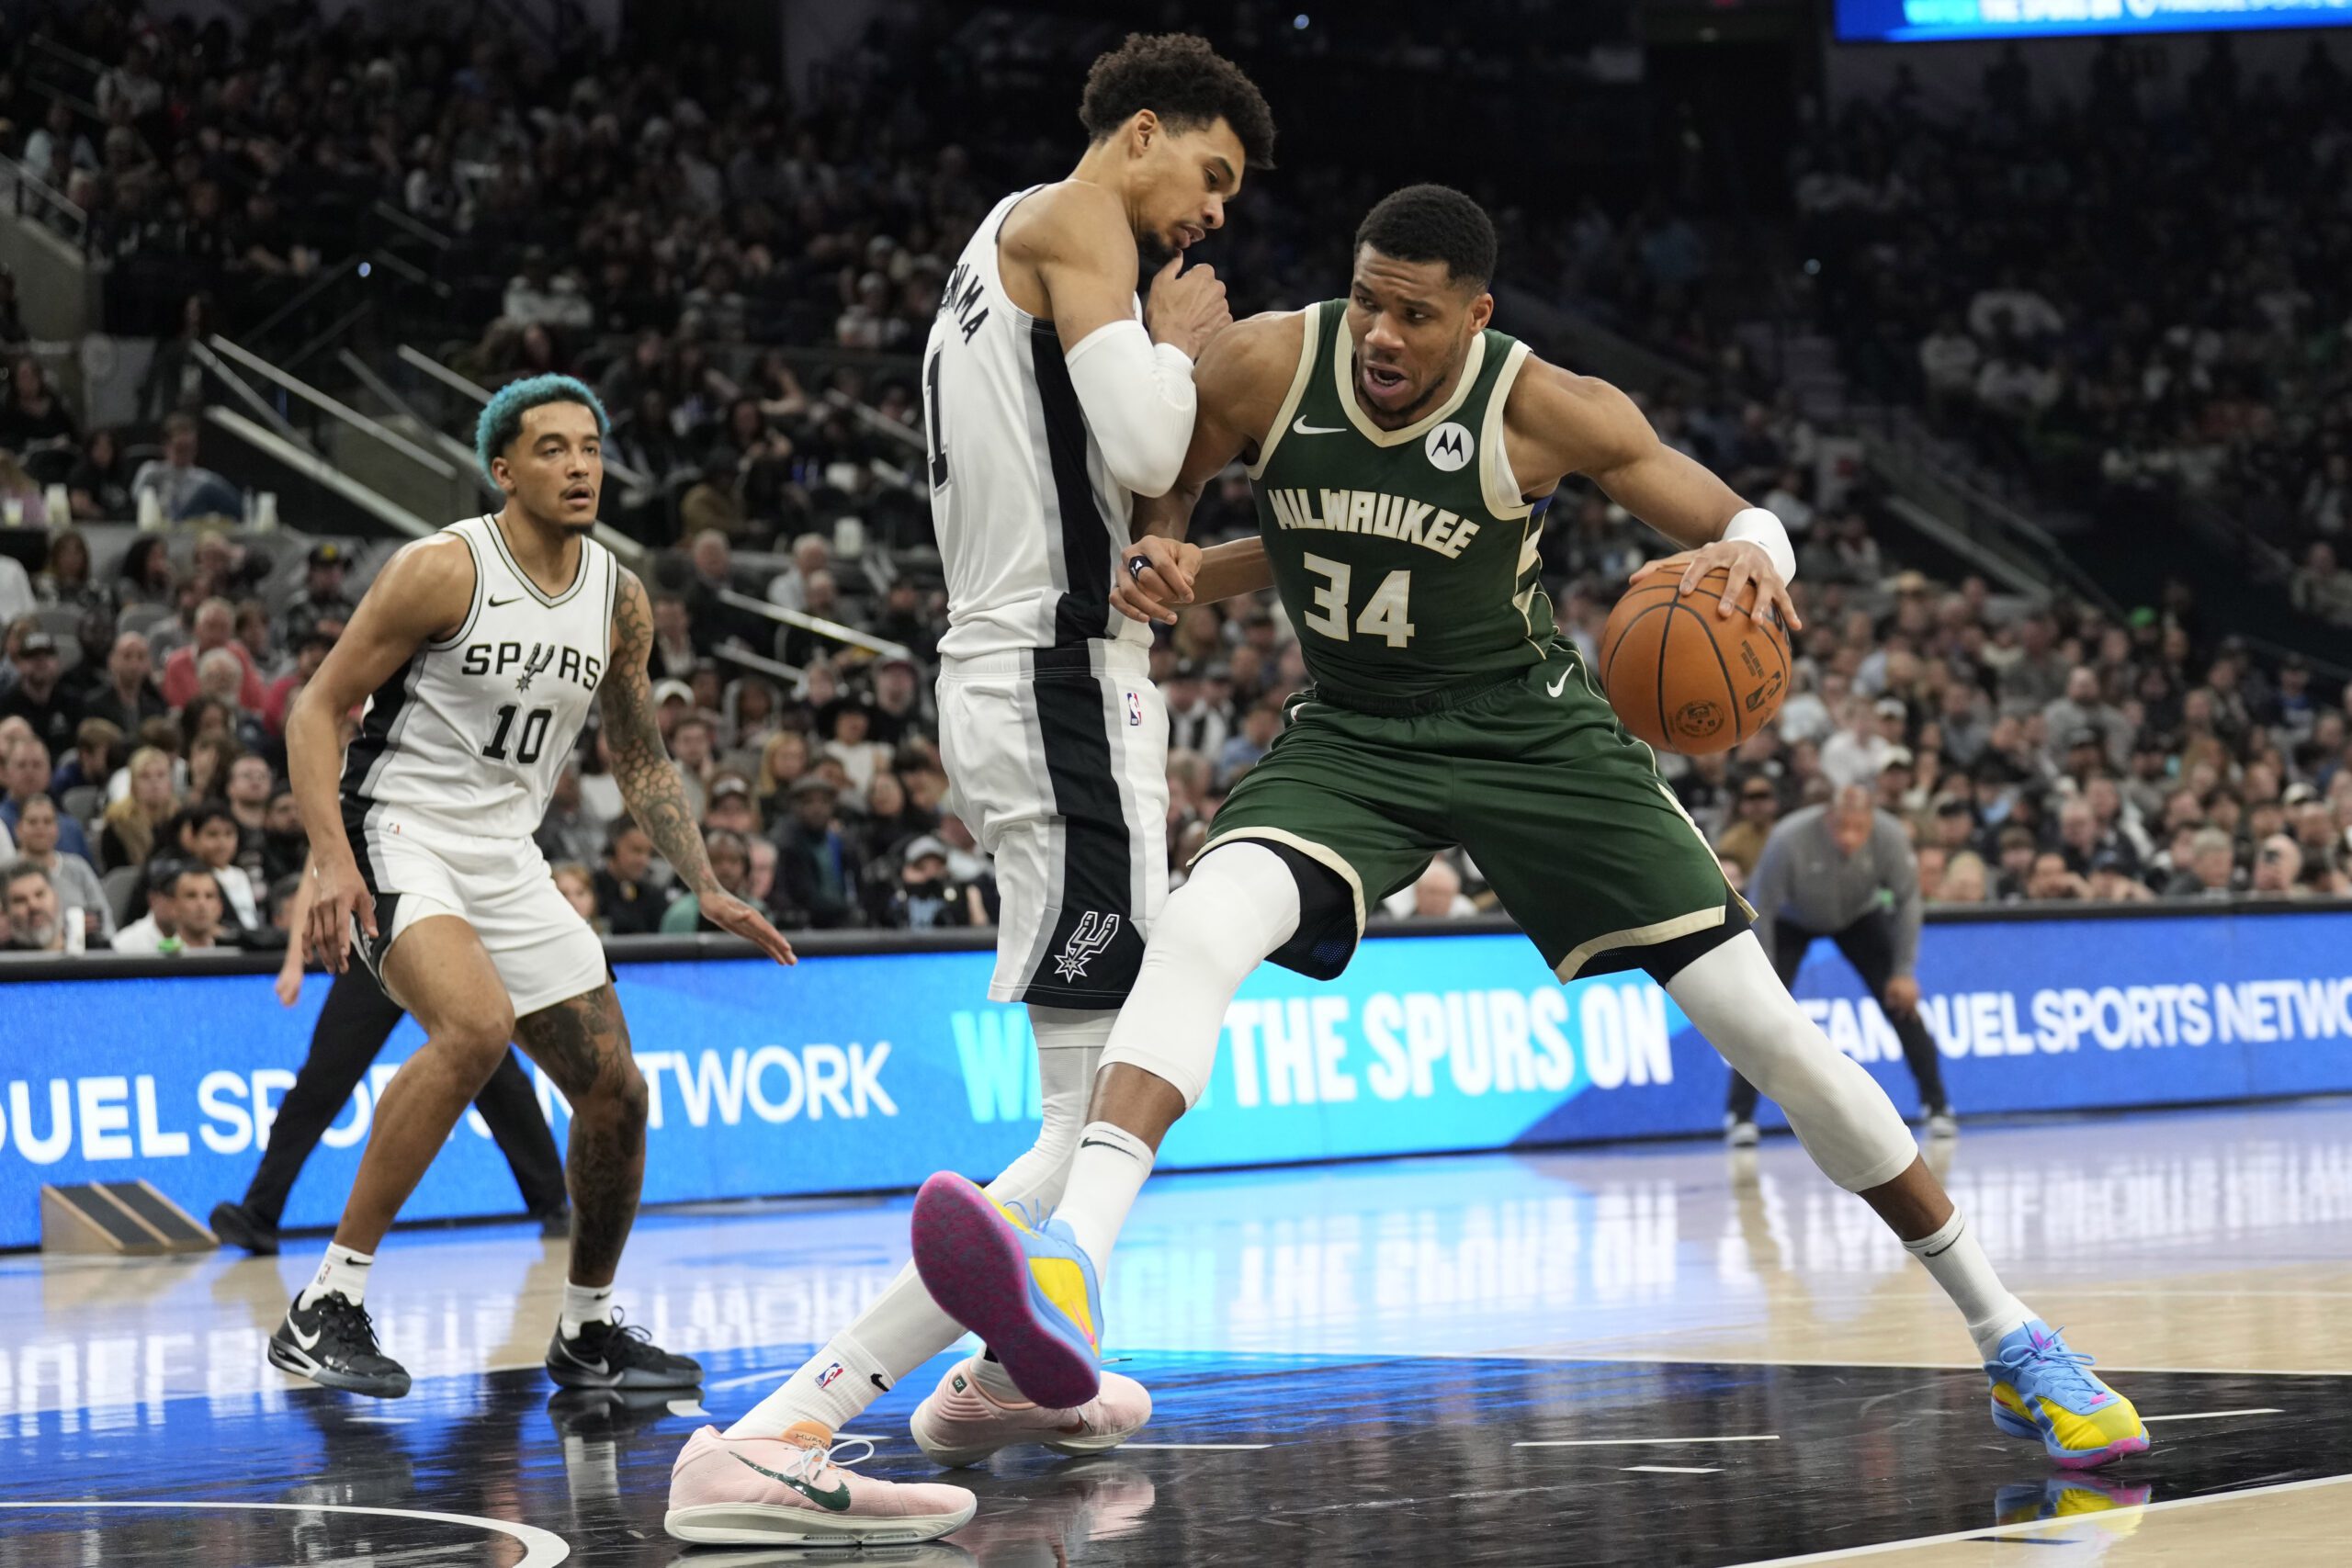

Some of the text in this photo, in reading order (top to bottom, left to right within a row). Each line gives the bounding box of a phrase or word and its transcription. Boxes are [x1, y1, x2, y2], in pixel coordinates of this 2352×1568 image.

[924, 348, 950, 491] 1
[1268, 488, 1480, 559] MILWAUKEE
[1304, 551, 1415, 648] 34
[461, 642, 601, 694] SPURS
[481, 705, 553, 764] 10
[1223, 983, 1674, 1108] THE SPURS ON
[2031, 983, 2212, 1055] SPORTS
[0, 1075, 190, 1165] UEL
[531, 1041, 899, 1129] NTWORK
